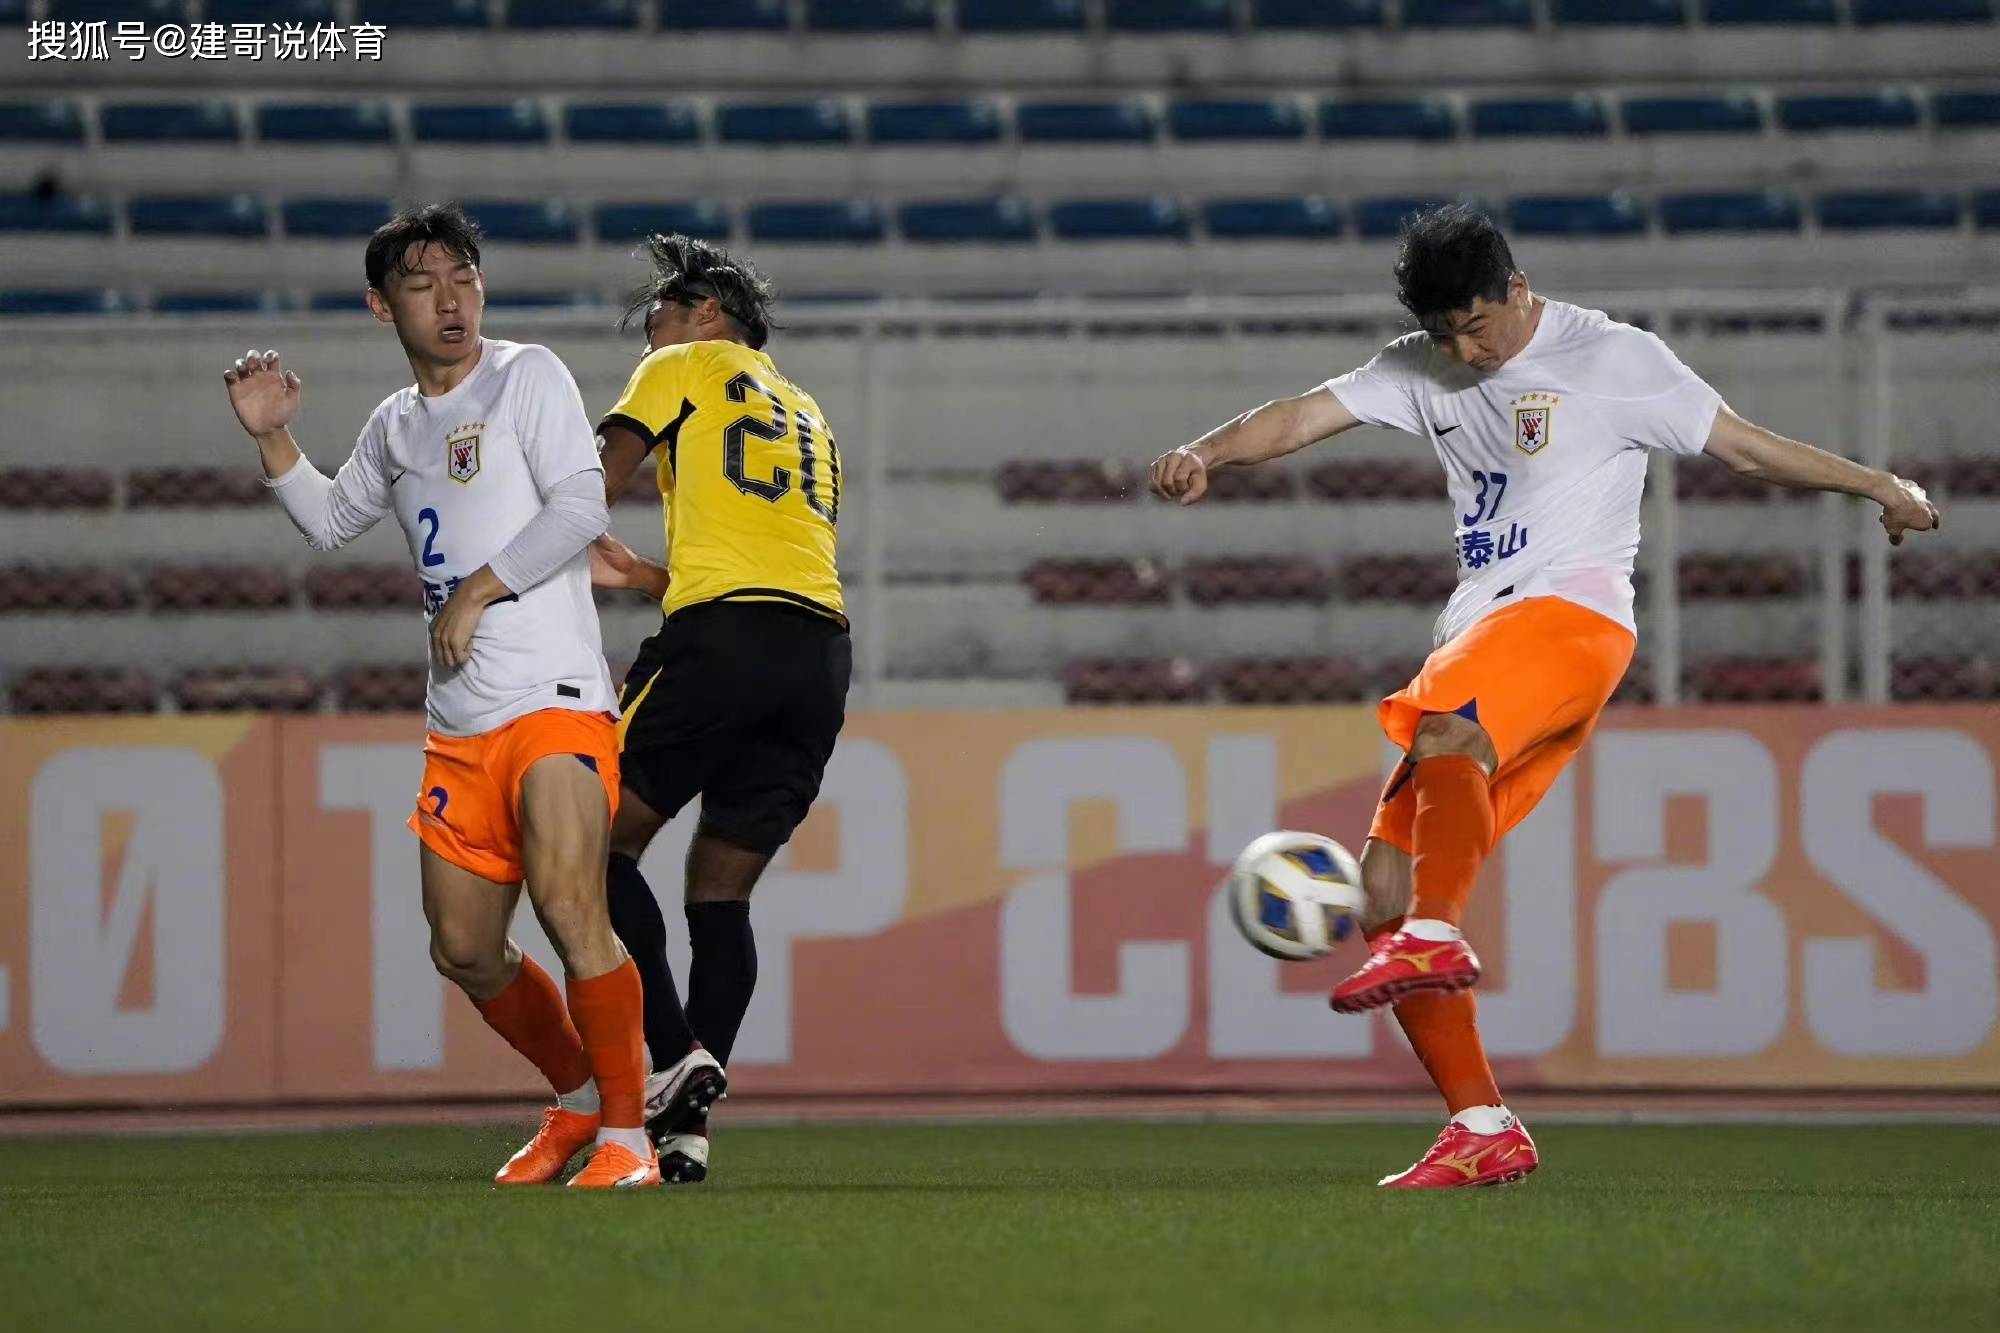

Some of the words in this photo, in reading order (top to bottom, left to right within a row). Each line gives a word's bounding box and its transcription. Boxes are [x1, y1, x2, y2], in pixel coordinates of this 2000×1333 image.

[723, 371, 840, 526] 20
[1463, 470, 1508, 527] 37
[418, 507, 446, 567] 2
[1456, 523, 1528, 570] 泰山
[0, 744, 226, 1076] 0
